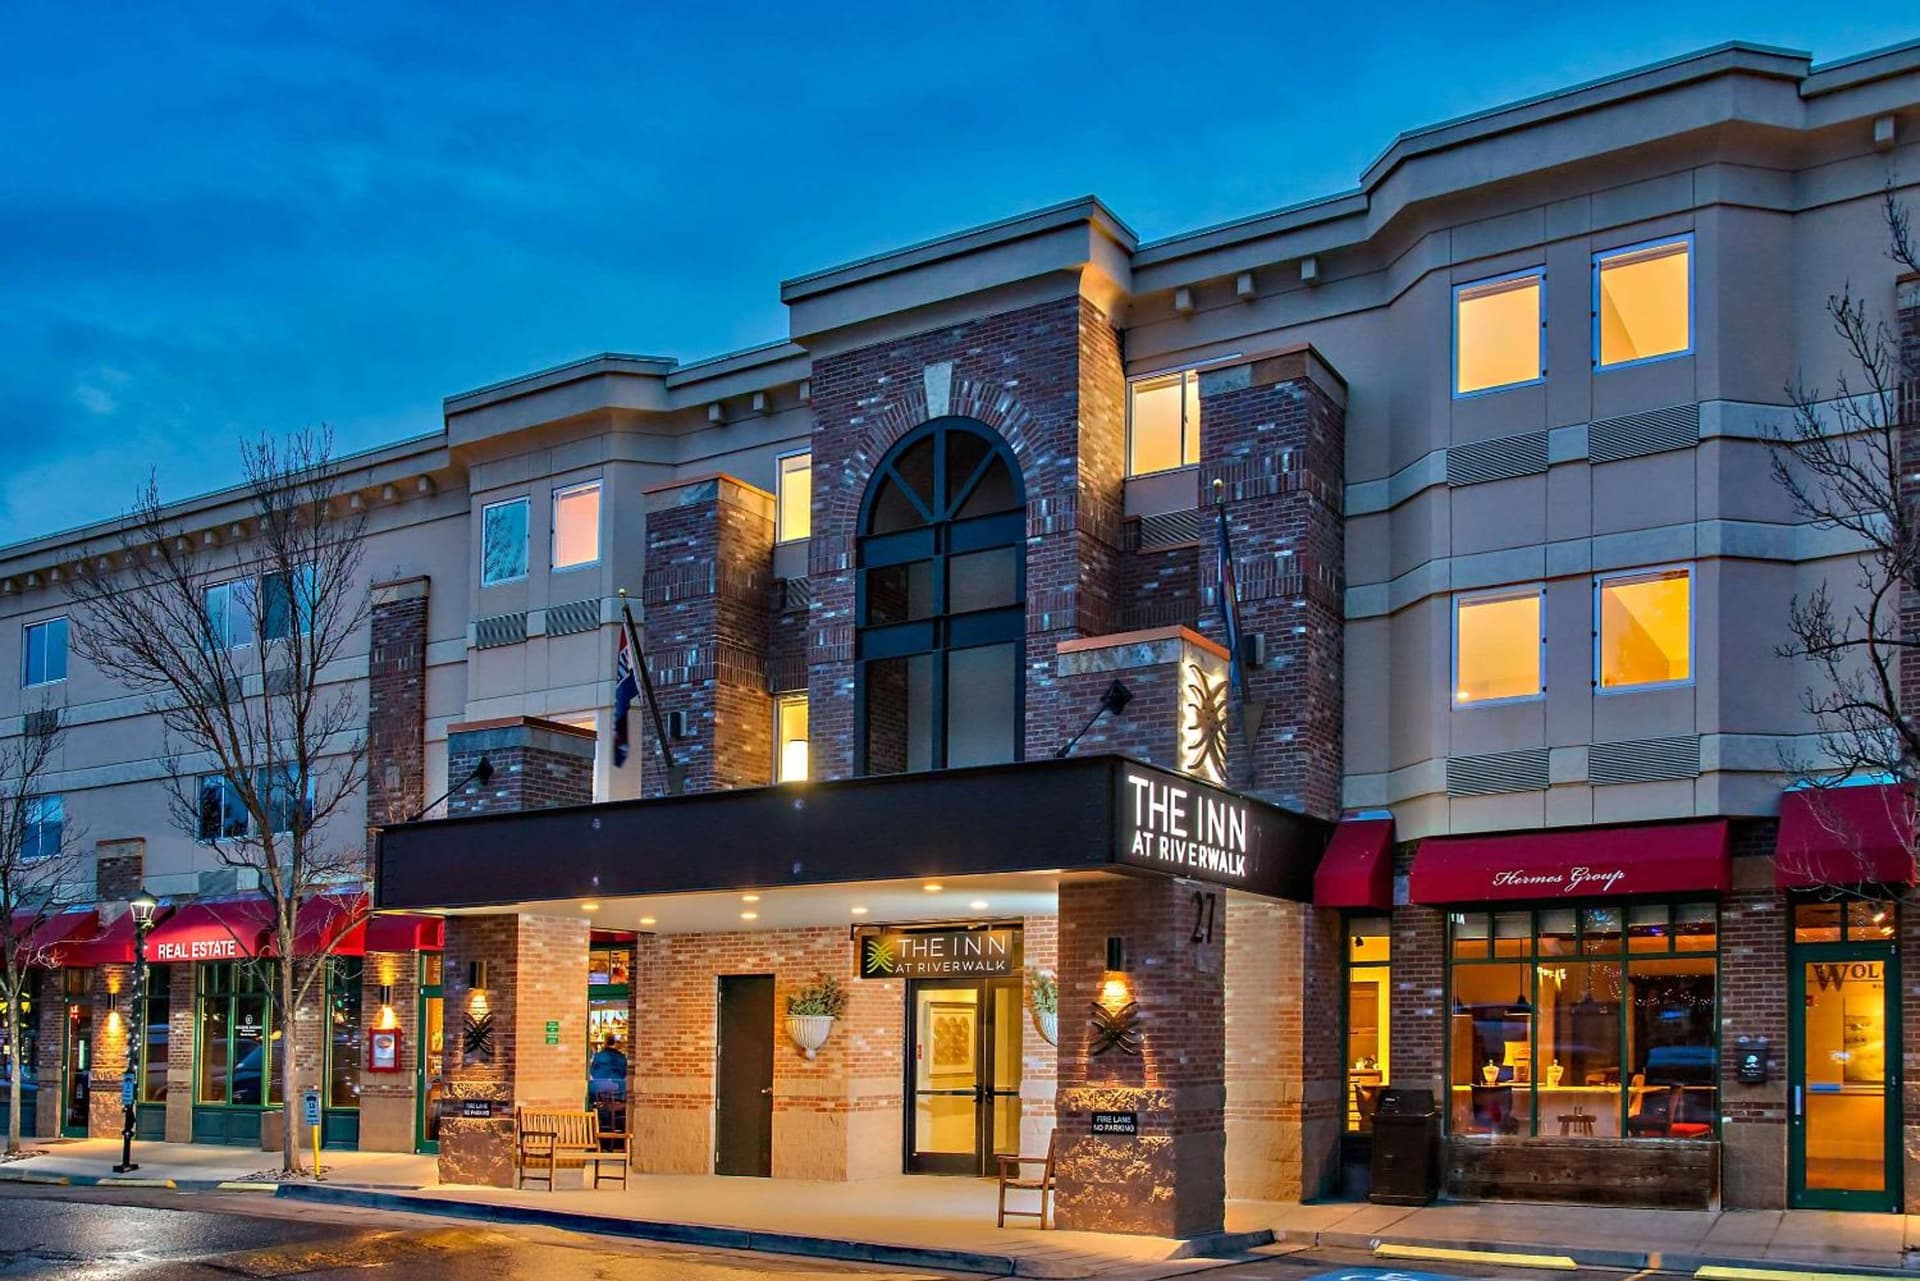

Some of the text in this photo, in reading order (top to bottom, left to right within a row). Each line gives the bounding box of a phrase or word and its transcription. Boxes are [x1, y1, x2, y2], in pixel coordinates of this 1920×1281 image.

[1128, 775, 1246, 853] THE INN
[1132, 830, 1246, 878] AT RIVERWALK
[1492, 866, 1626, 892] Hermes Group
[158, 939, 236, 959] REAL ESTATE
[896, 935, 1006, 958] THE INN
[895, 960, 1006, 974] AT RIVERWALK
[1812, 963, 1884, 992] WOL
[1096, 1115, 1112, 1123] FIRE
[1105, 1124, 1135, 1132] PARKING
